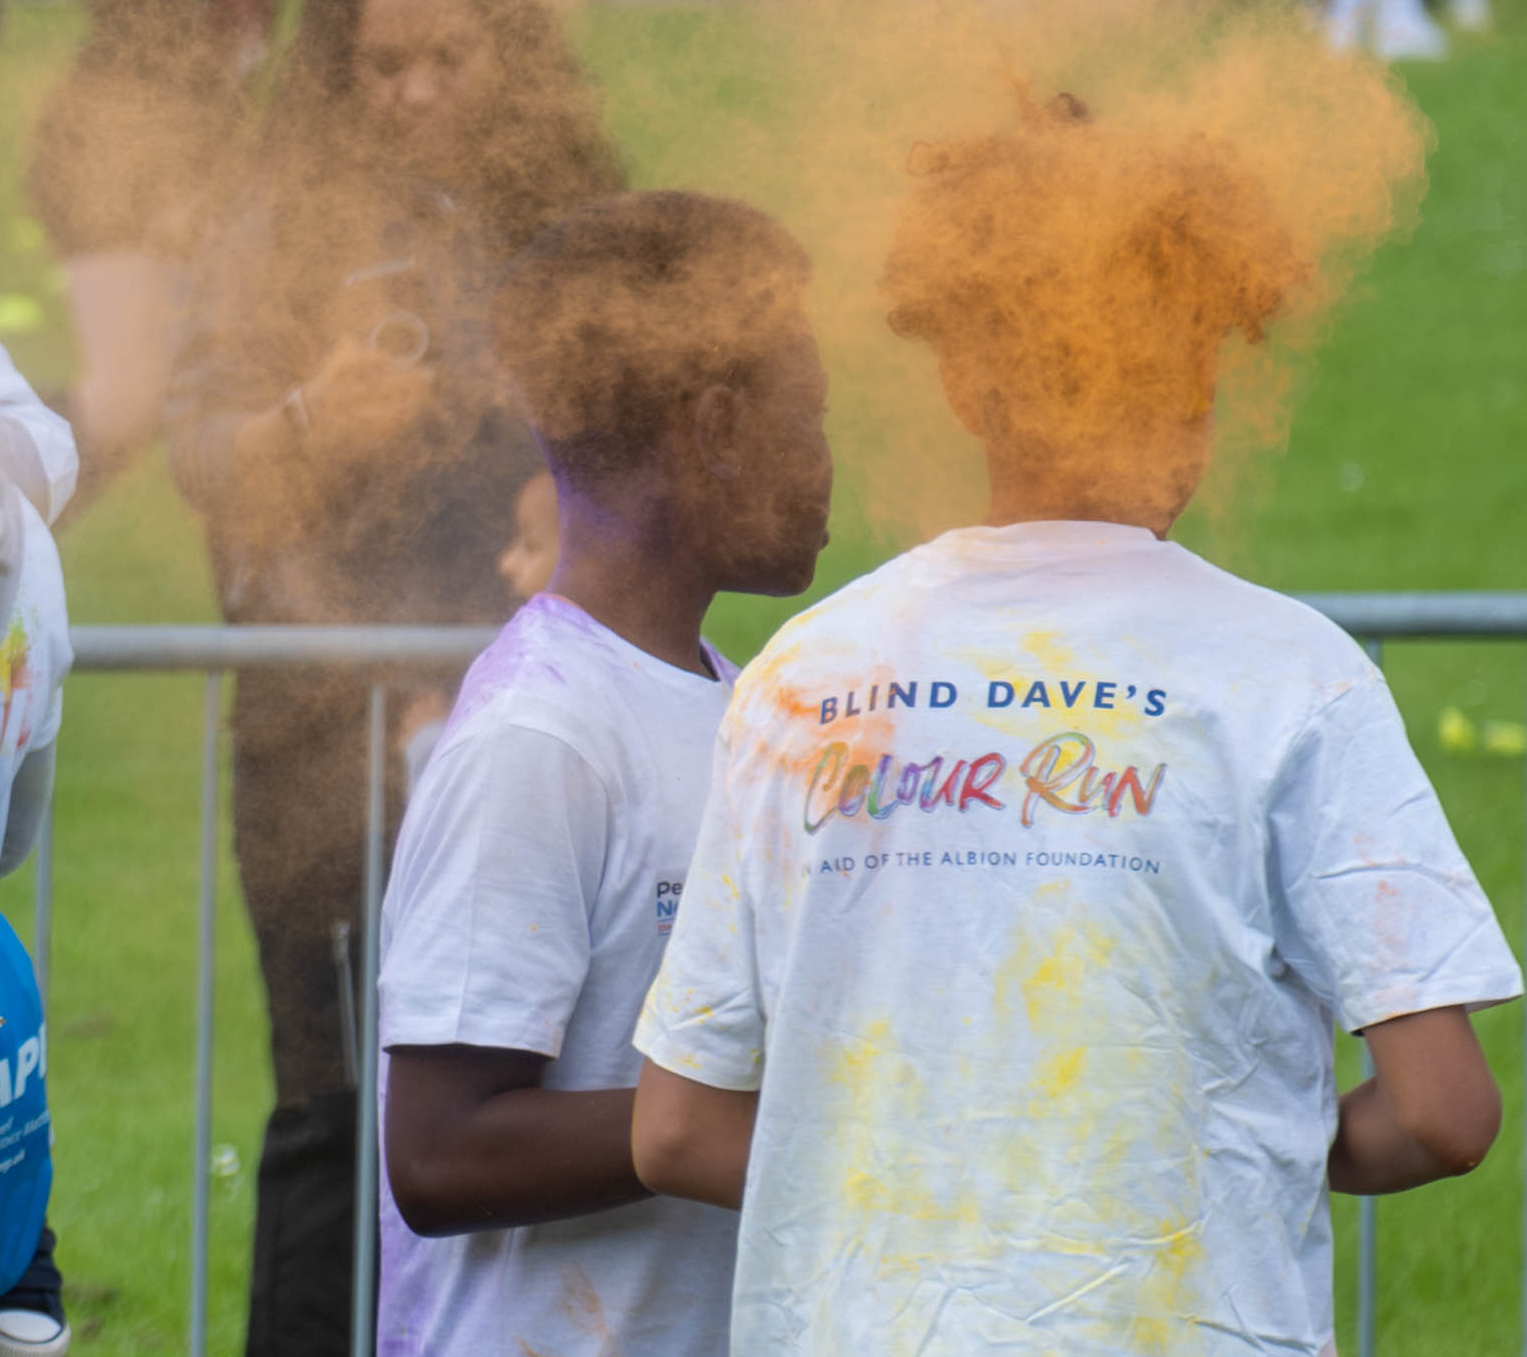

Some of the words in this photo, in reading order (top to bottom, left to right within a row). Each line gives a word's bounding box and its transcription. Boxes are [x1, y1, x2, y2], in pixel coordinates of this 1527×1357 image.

[819, 681, 958, 725] BLIND
[986, 680, 1167, 717] DAVE'S
[820, 856, 856, 874] AID
[864, 853, 890, 870] OF
[897, 850, 933, 867] THE
[940, 850, 1017, 867] ALBION
[1025, 851, 1161, 875] FOUNDATION
